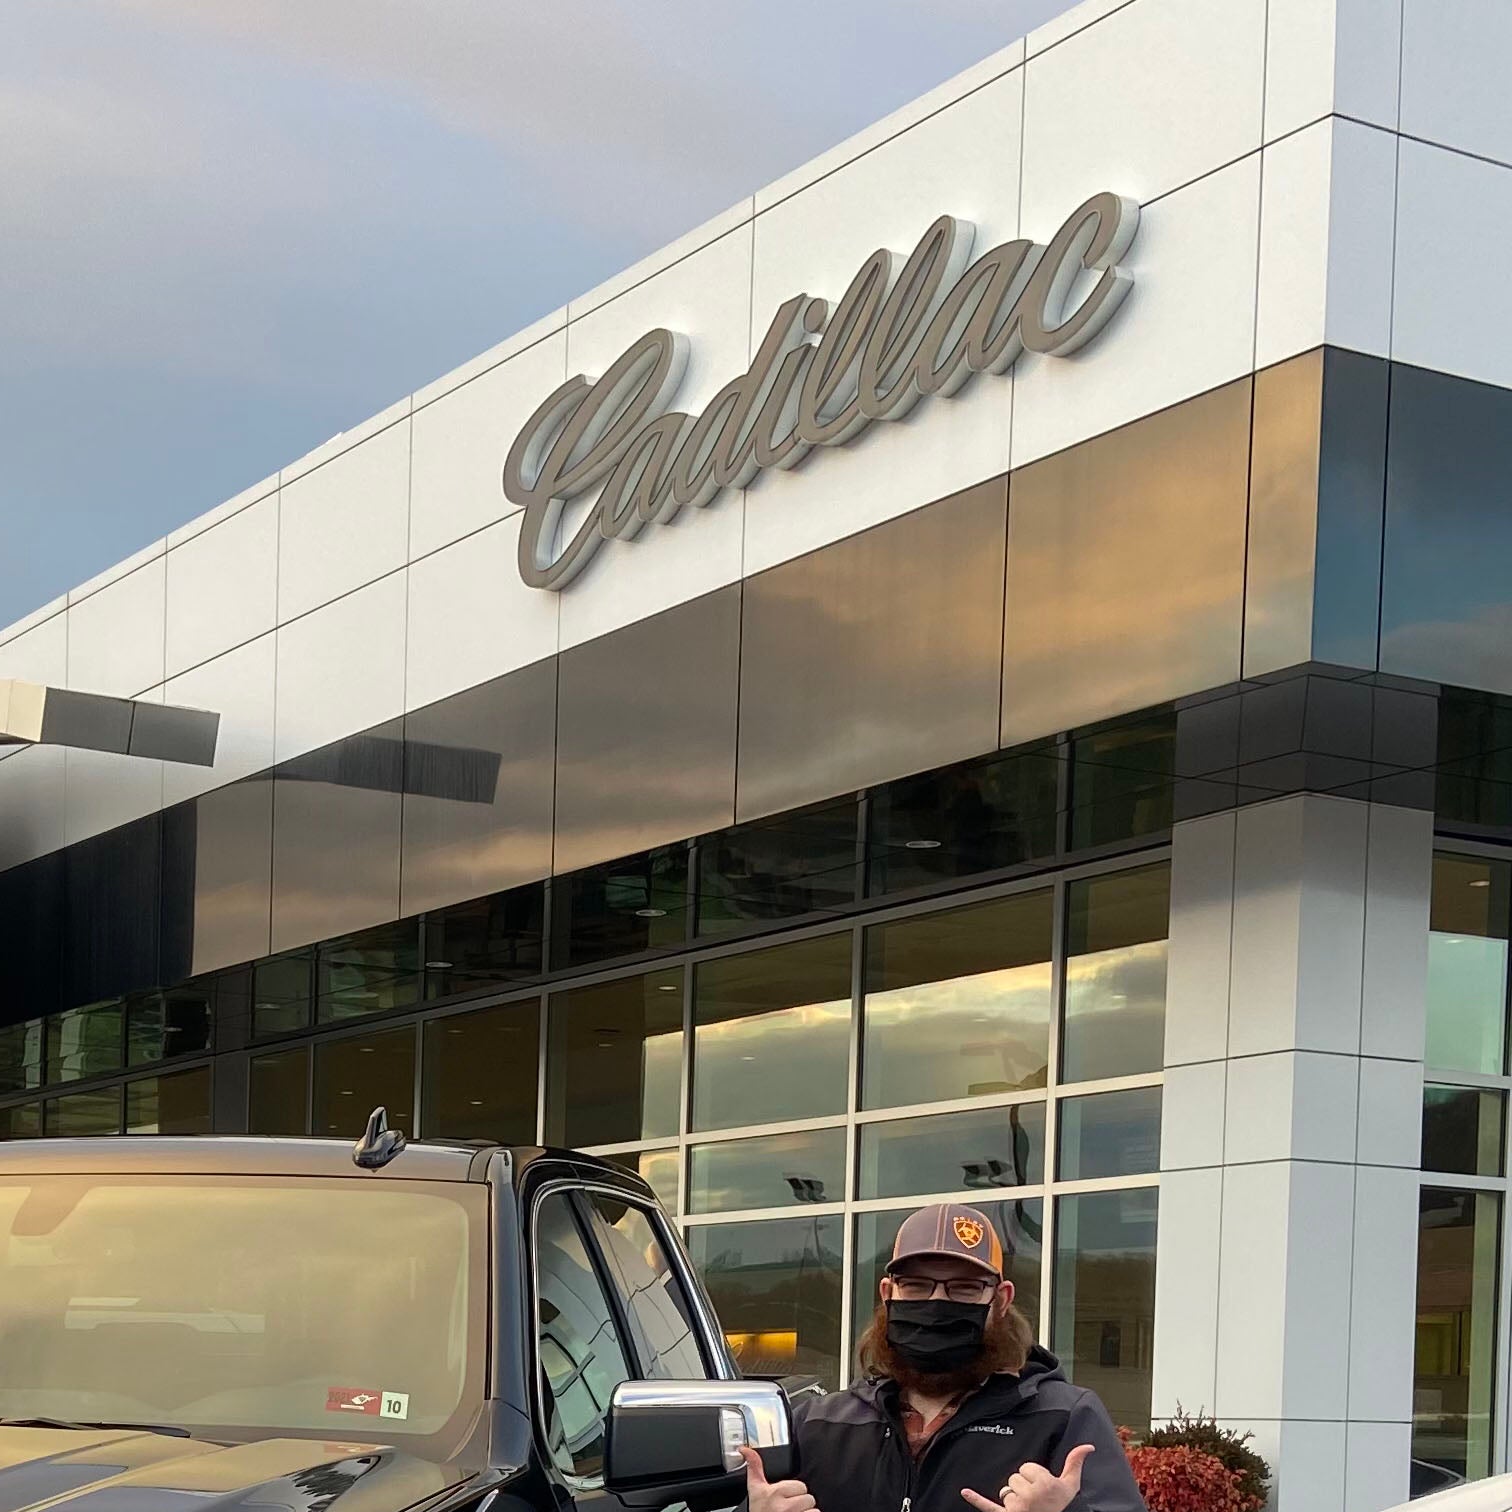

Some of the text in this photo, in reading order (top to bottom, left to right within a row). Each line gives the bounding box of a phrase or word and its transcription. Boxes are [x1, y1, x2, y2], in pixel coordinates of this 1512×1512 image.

[502, 190, 1136, 592] Cadillac
[386, 1399, 402, 1415] 10
[967, 1424, 1014, 1435] averick
